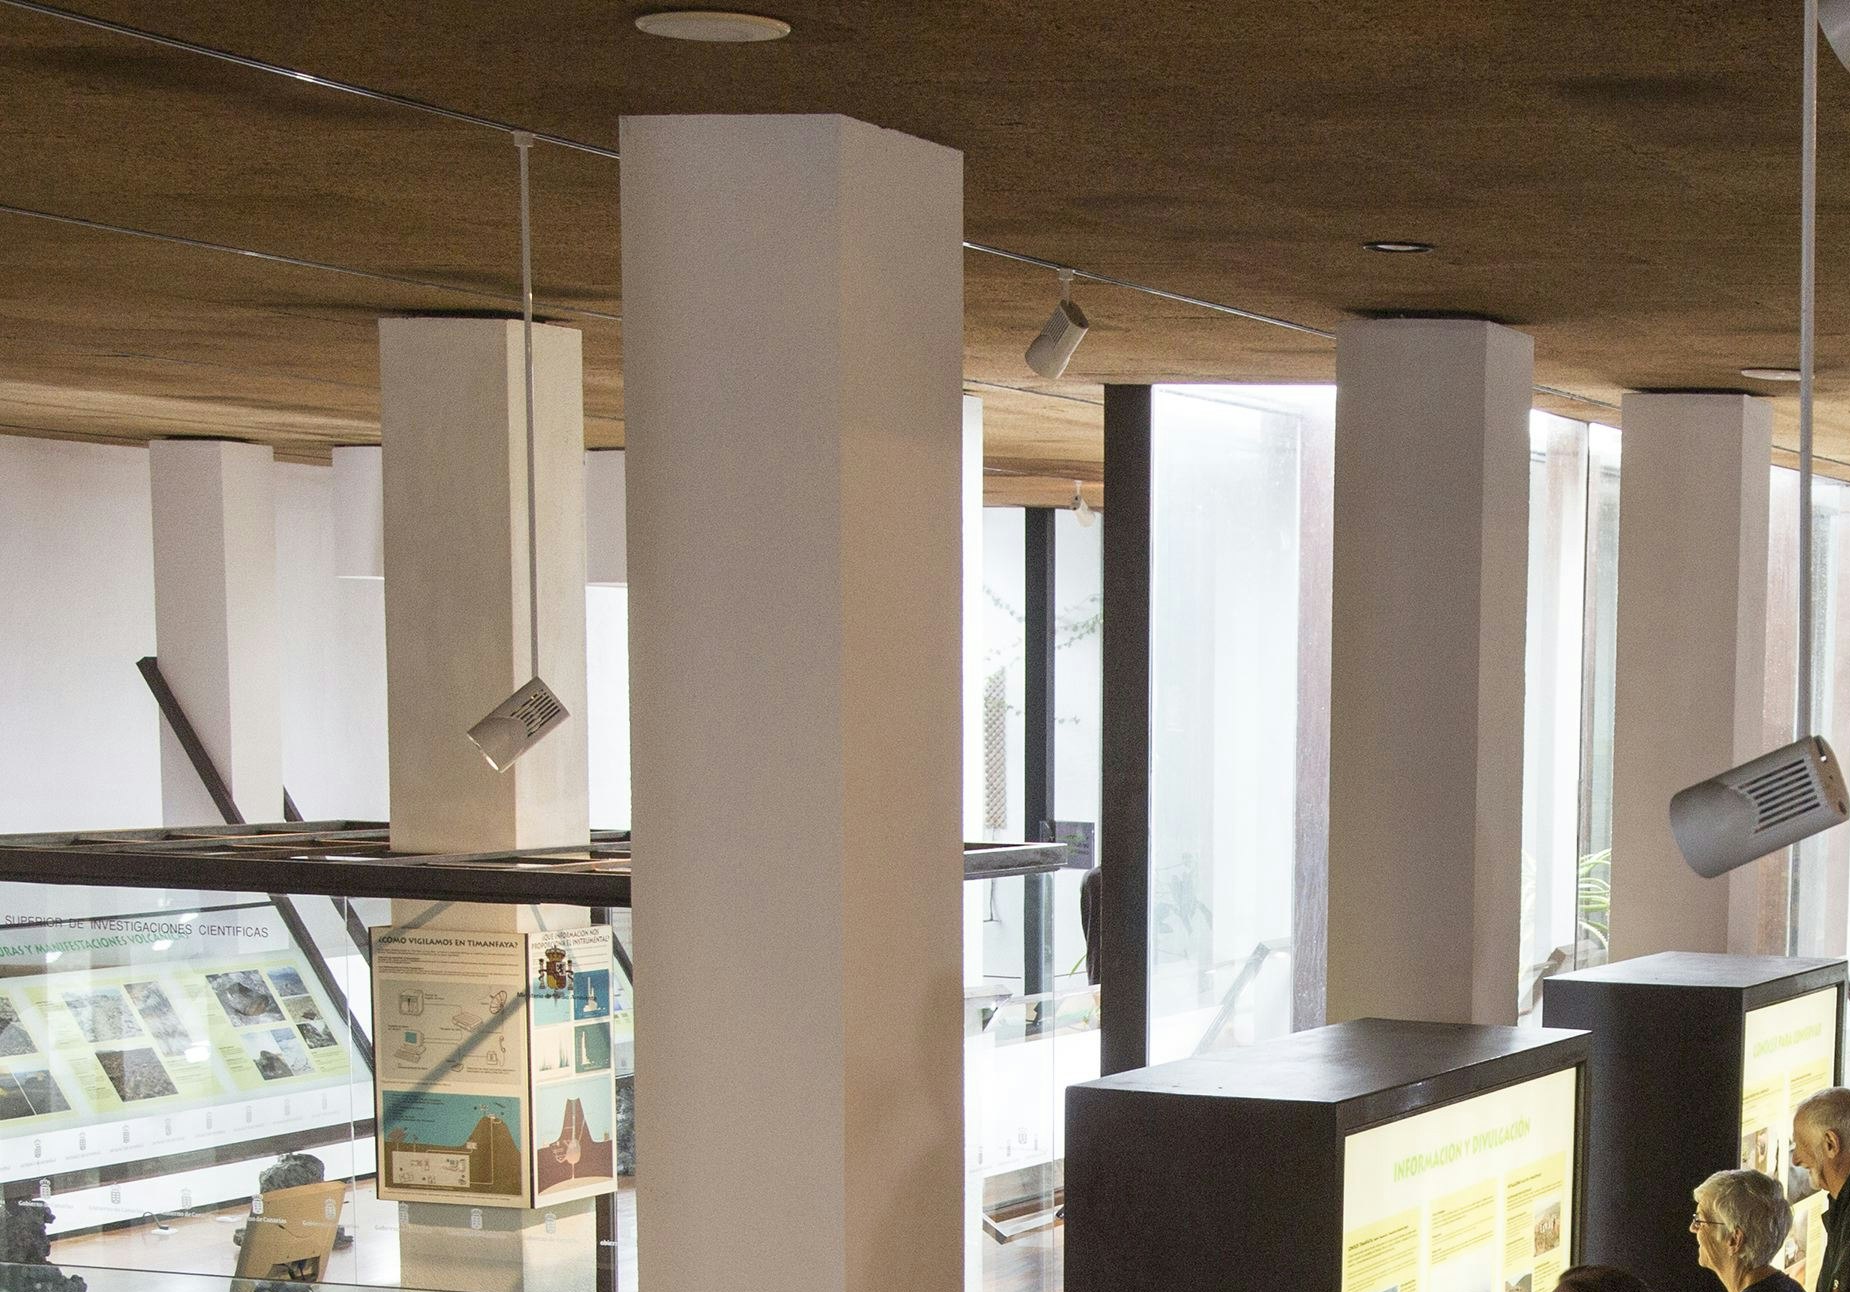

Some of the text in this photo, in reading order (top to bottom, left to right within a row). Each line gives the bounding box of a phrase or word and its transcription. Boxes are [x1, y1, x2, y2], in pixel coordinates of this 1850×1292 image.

[5, 915, 269, 939] SUPERIOR DE INVESTIGACIONES CIENTIFICAS
[37, 936, 128, 953] MANIFESTACIONES
[409, 937, 453, 946] VIGILAMOS
[467, 940, 519, 949] TIMANFAYA?
